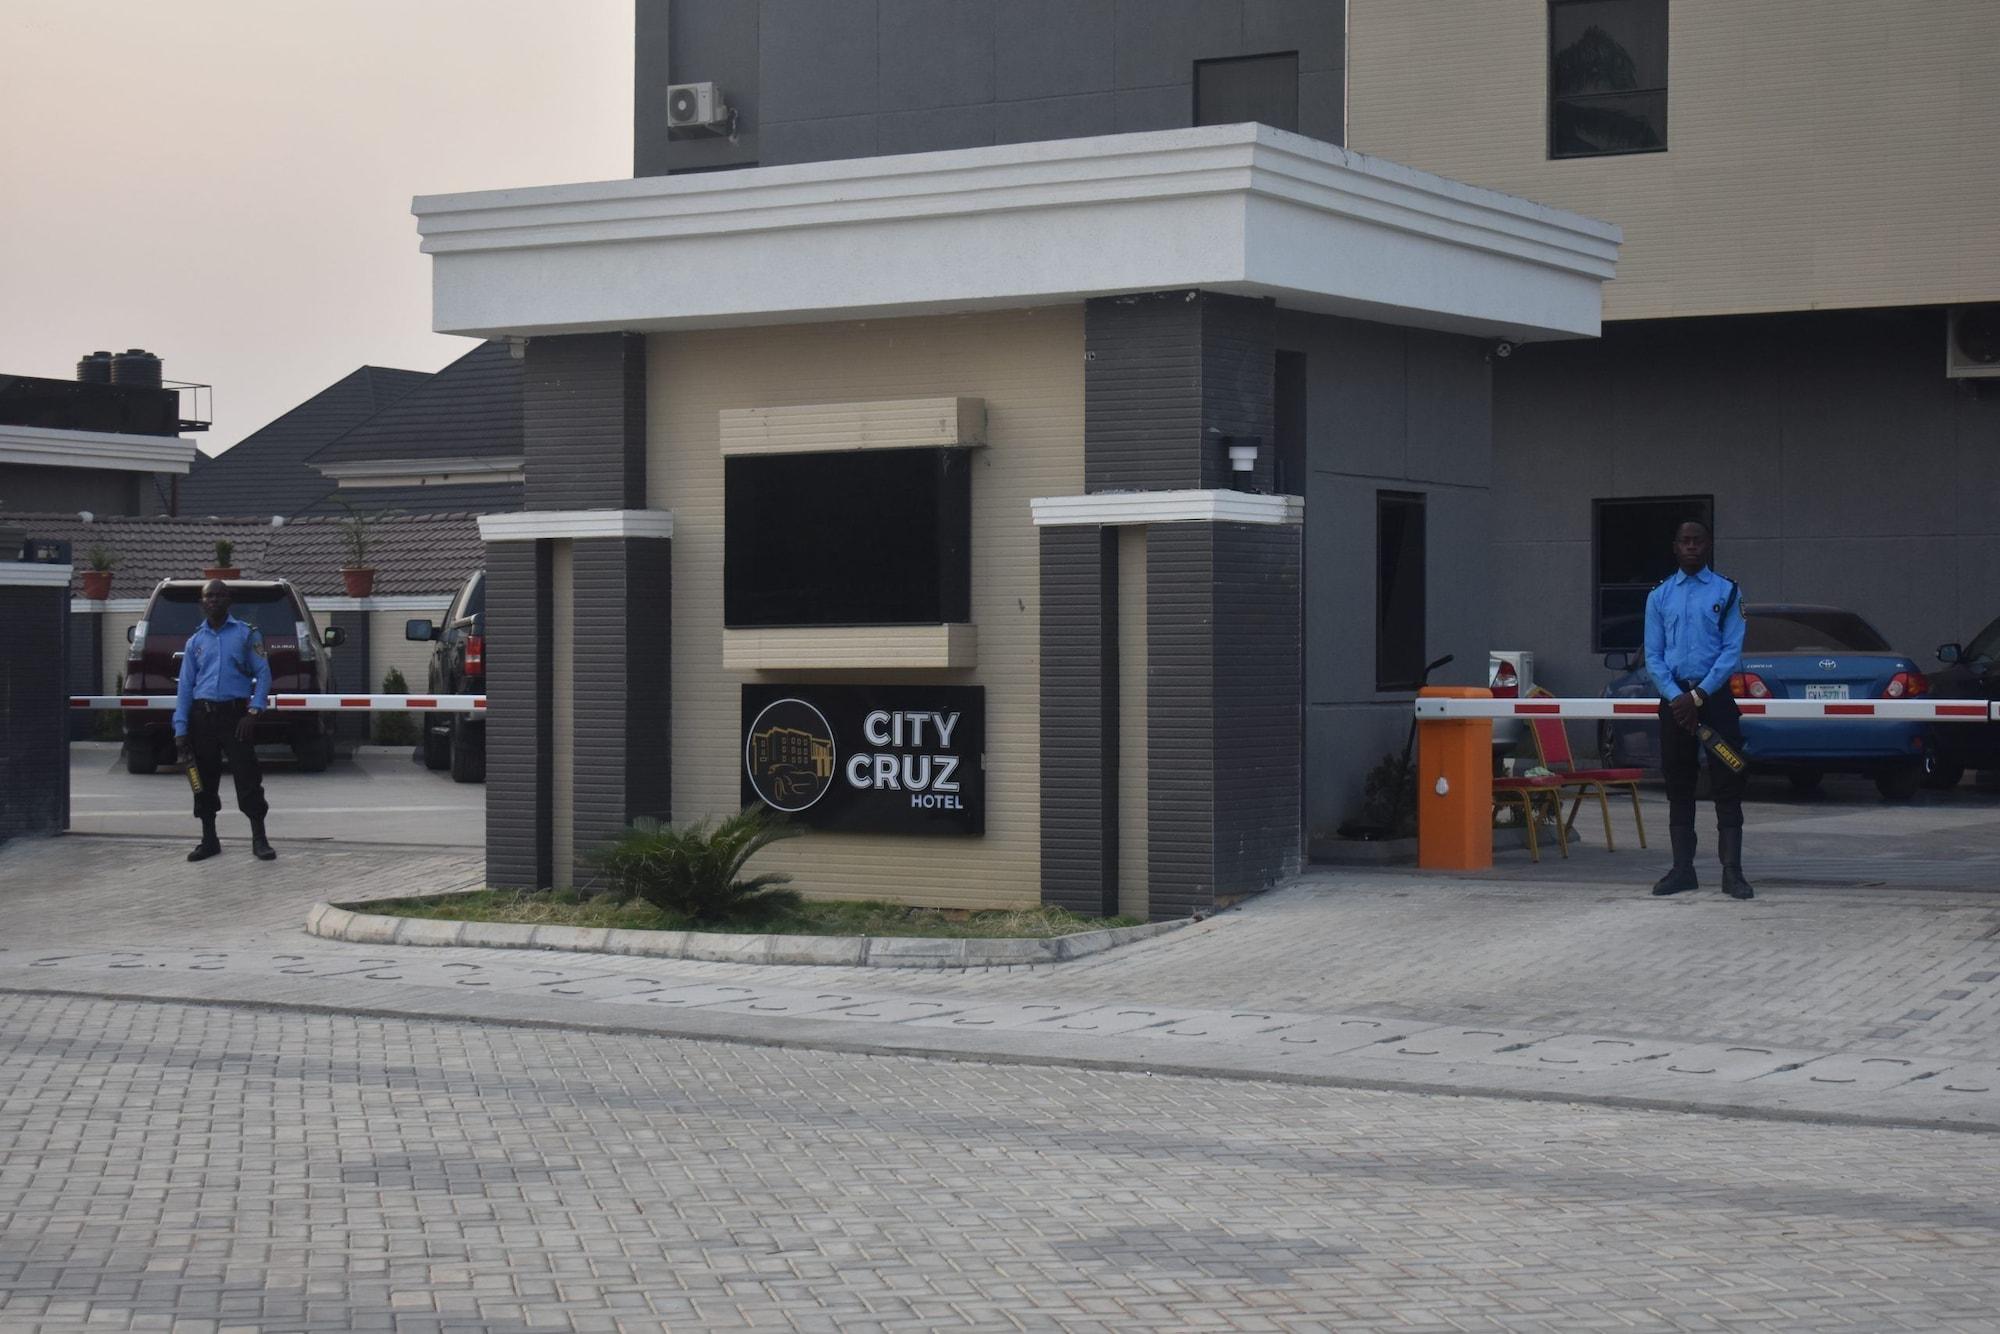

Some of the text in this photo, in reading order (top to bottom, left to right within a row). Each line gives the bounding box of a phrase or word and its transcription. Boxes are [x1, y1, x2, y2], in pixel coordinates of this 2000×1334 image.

[863, 710, 961, 748] CITY
[845, 752, 961, 792] CRUZ
[911, 794, 964, 809] HOTEL
